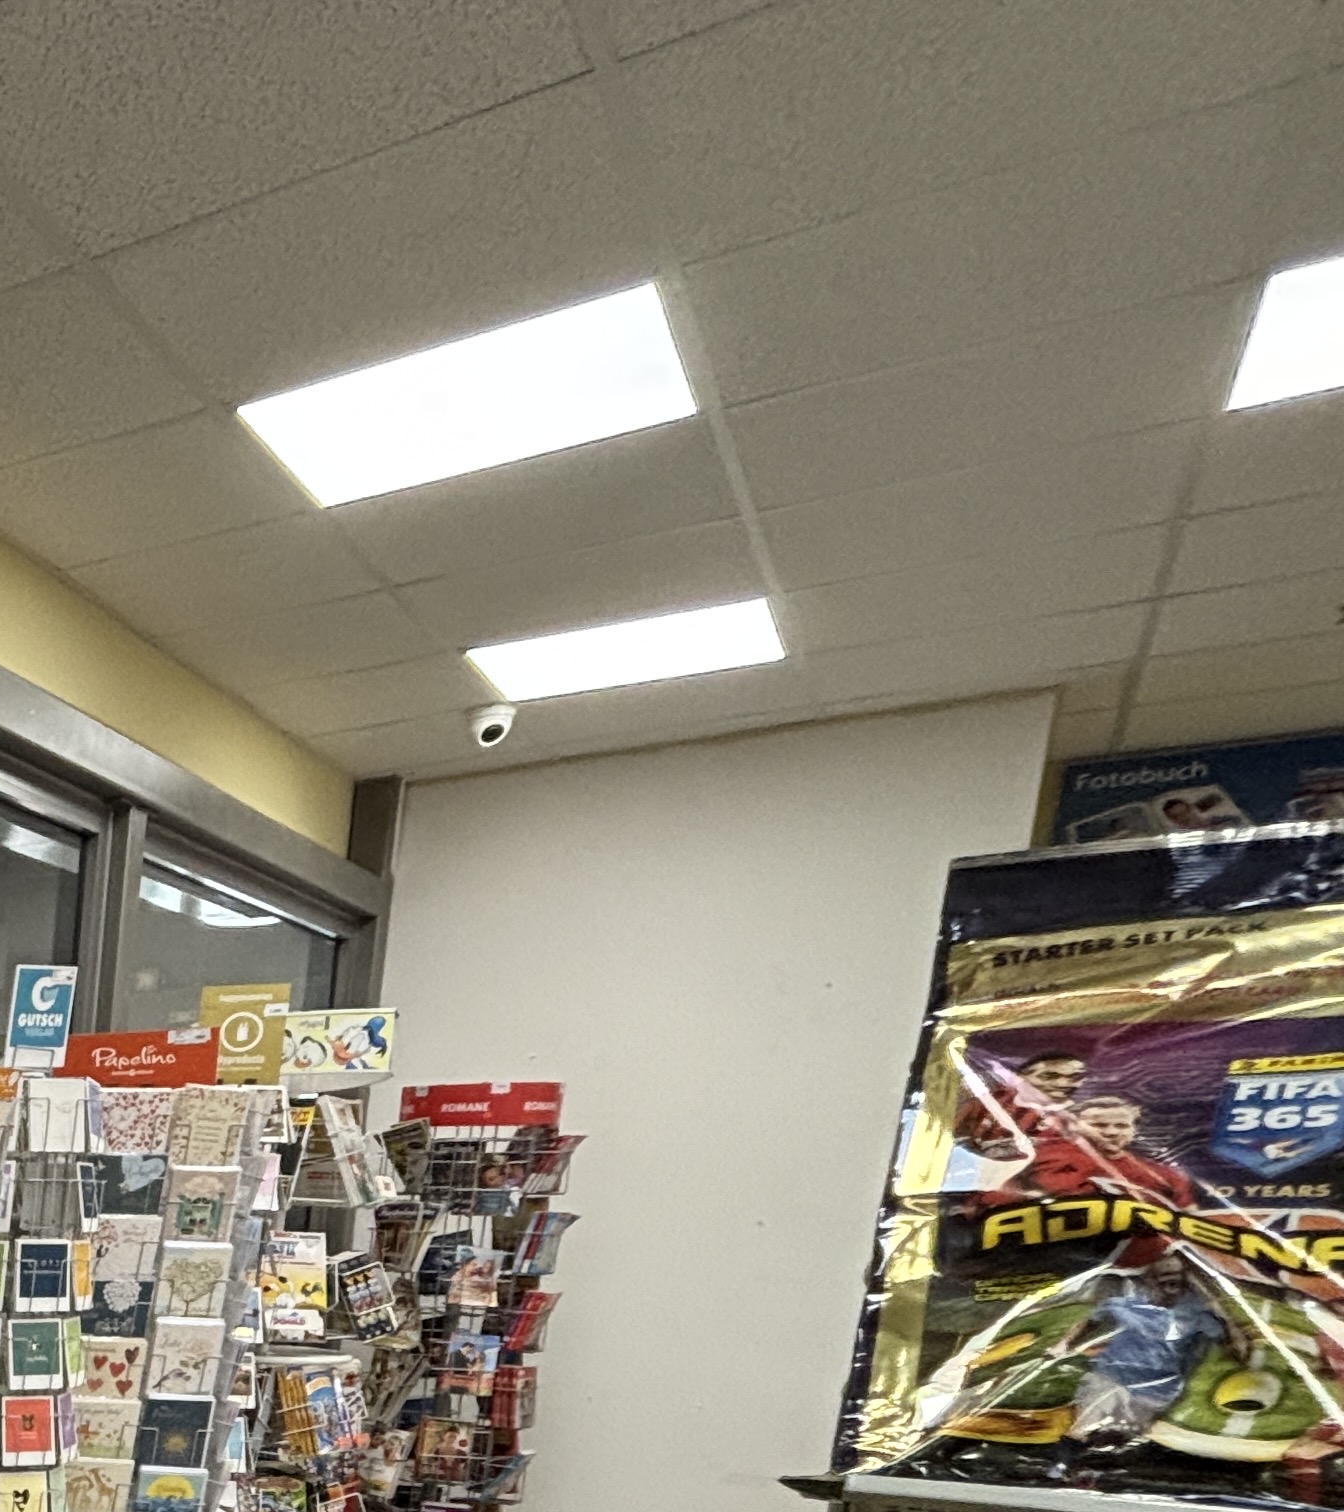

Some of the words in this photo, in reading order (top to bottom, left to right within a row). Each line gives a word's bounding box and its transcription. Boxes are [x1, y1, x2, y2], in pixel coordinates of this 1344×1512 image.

[1074, 760, 1208, 792] Fotobuch
[992, 936, 1115, 969] STARTER
[1124, 928, 1174, 949] SET
[1185, 919, 1269, 942] PACK
[16, 1012, 64, 1028] GUTSCH
[91, 1043, 177, 1068] Papelino
[1233, 1079, 1344, 1102] FIFA
[1227, 1104, 1340, 1132] 365
[1242, 1182, 1332, 1199] YEARS
